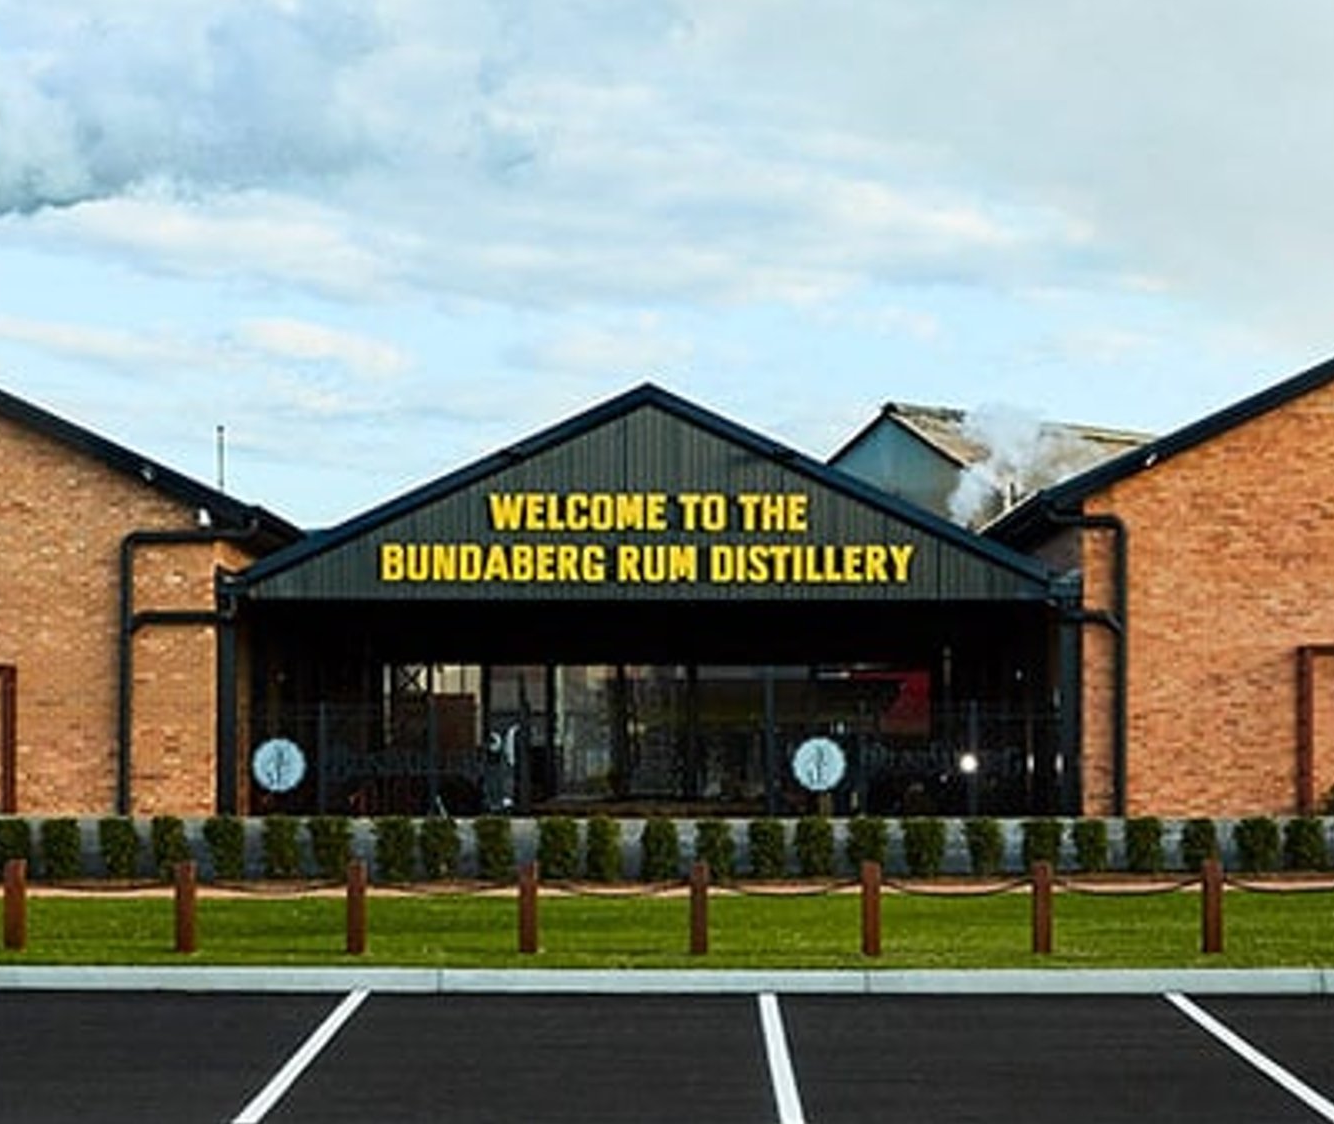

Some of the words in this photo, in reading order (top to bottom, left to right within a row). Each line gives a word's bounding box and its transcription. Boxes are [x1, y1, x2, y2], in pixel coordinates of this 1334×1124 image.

[488, 492, 668, 531] WELCOME
[678, 492, 727, 531] TO
[738, 492, 809, 531] THE
[380, 543, 606, 583] BUNDABERG
[617, 543, 698, 583] RUM
[710, 543, 915, 583] DISTILLERY
